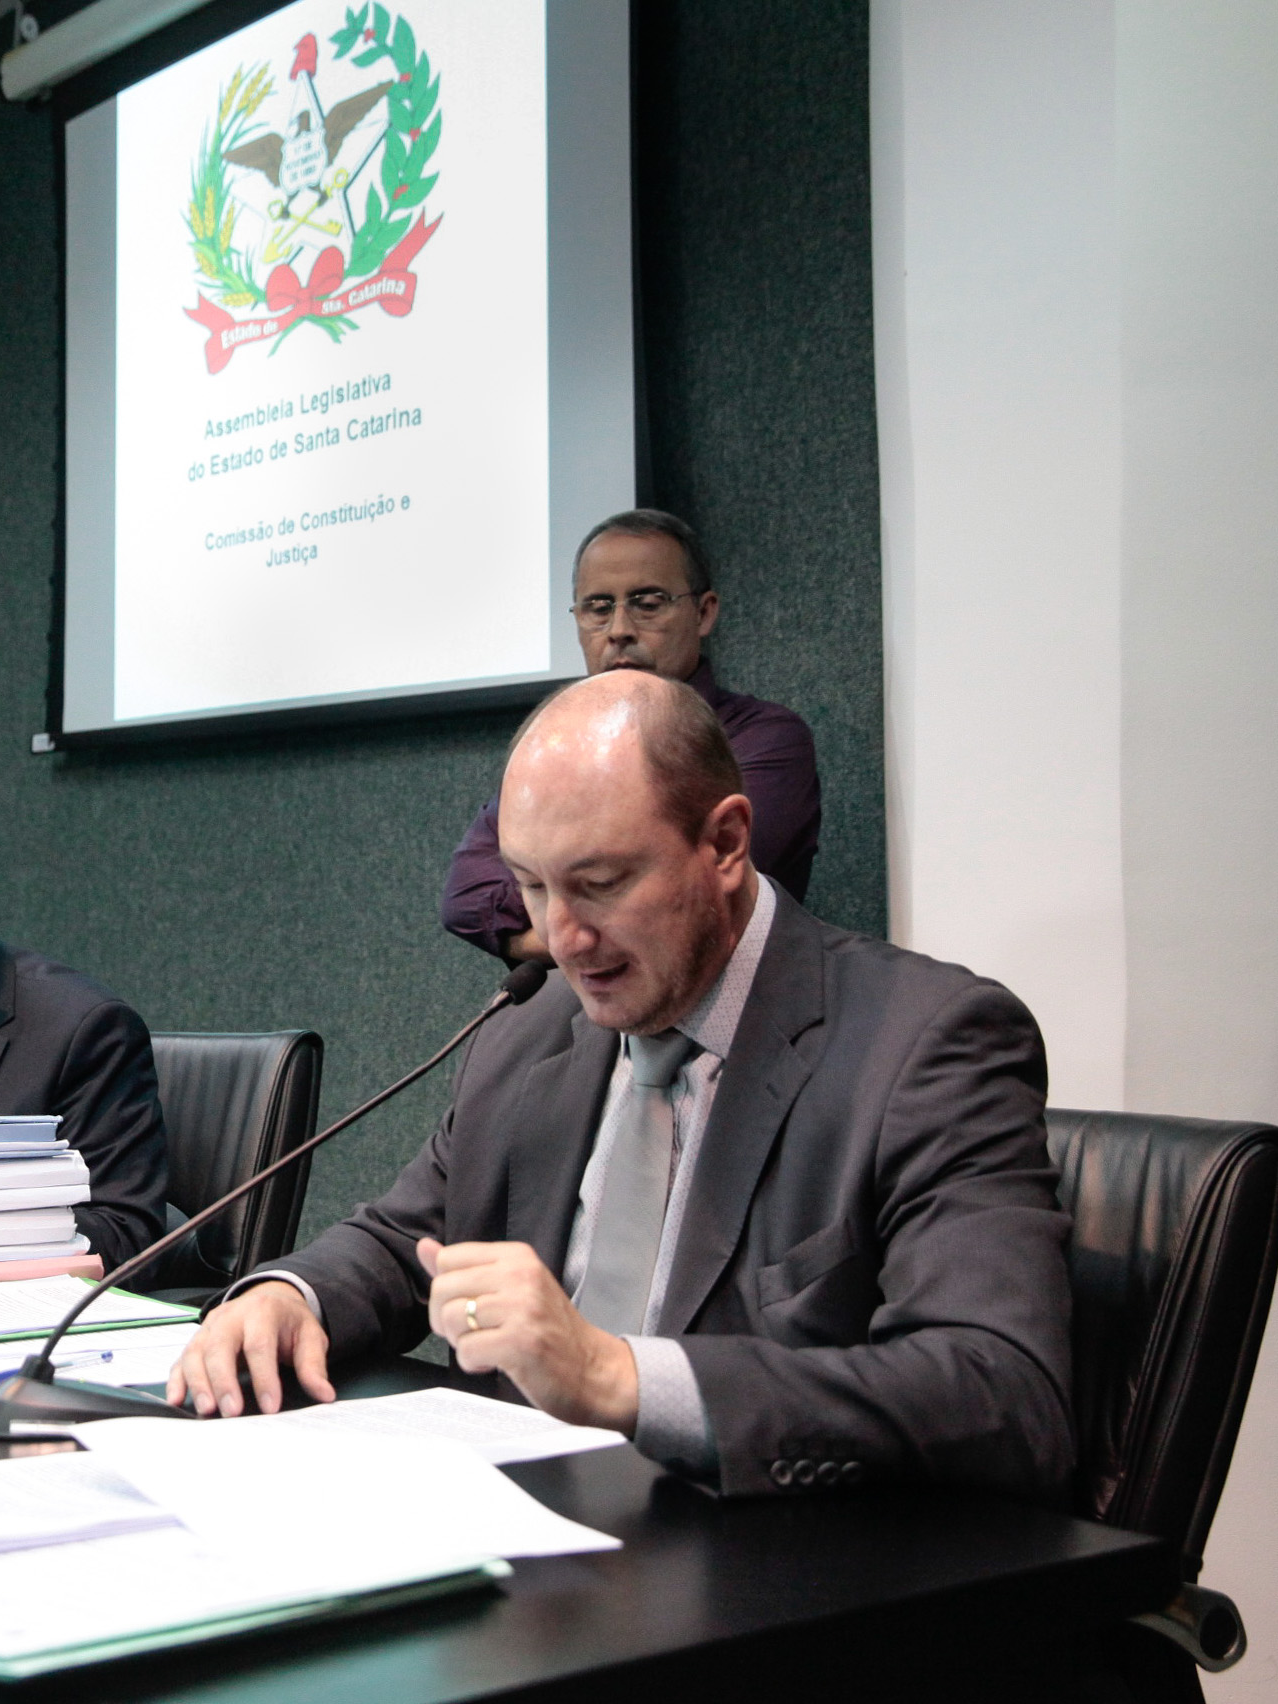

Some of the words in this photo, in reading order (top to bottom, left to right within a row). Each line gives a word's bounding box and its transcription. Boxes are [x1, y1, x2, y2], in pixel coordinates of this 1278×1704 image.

[348, 277, 406, 306] Catarina
[262, 319, 279, 336] de
[204, 398, 294, 440] Assembleia
[300, 372, 391, 415] Legislativa
[187, 461, 205, 482] do
[210, 446, 264, 476] Estado
[269, 439, 288, 460] de
[293, 426, 341, 455] Santa
[346, 406, 422, 442] Catarina
[205, 520, 274, 551] Comissão
[278, 516, 295, 536] de
[300, 493, 395, 532] Constituição
[400, 494, 411, 511] e
[265, 542, 318, 568] Justiça
